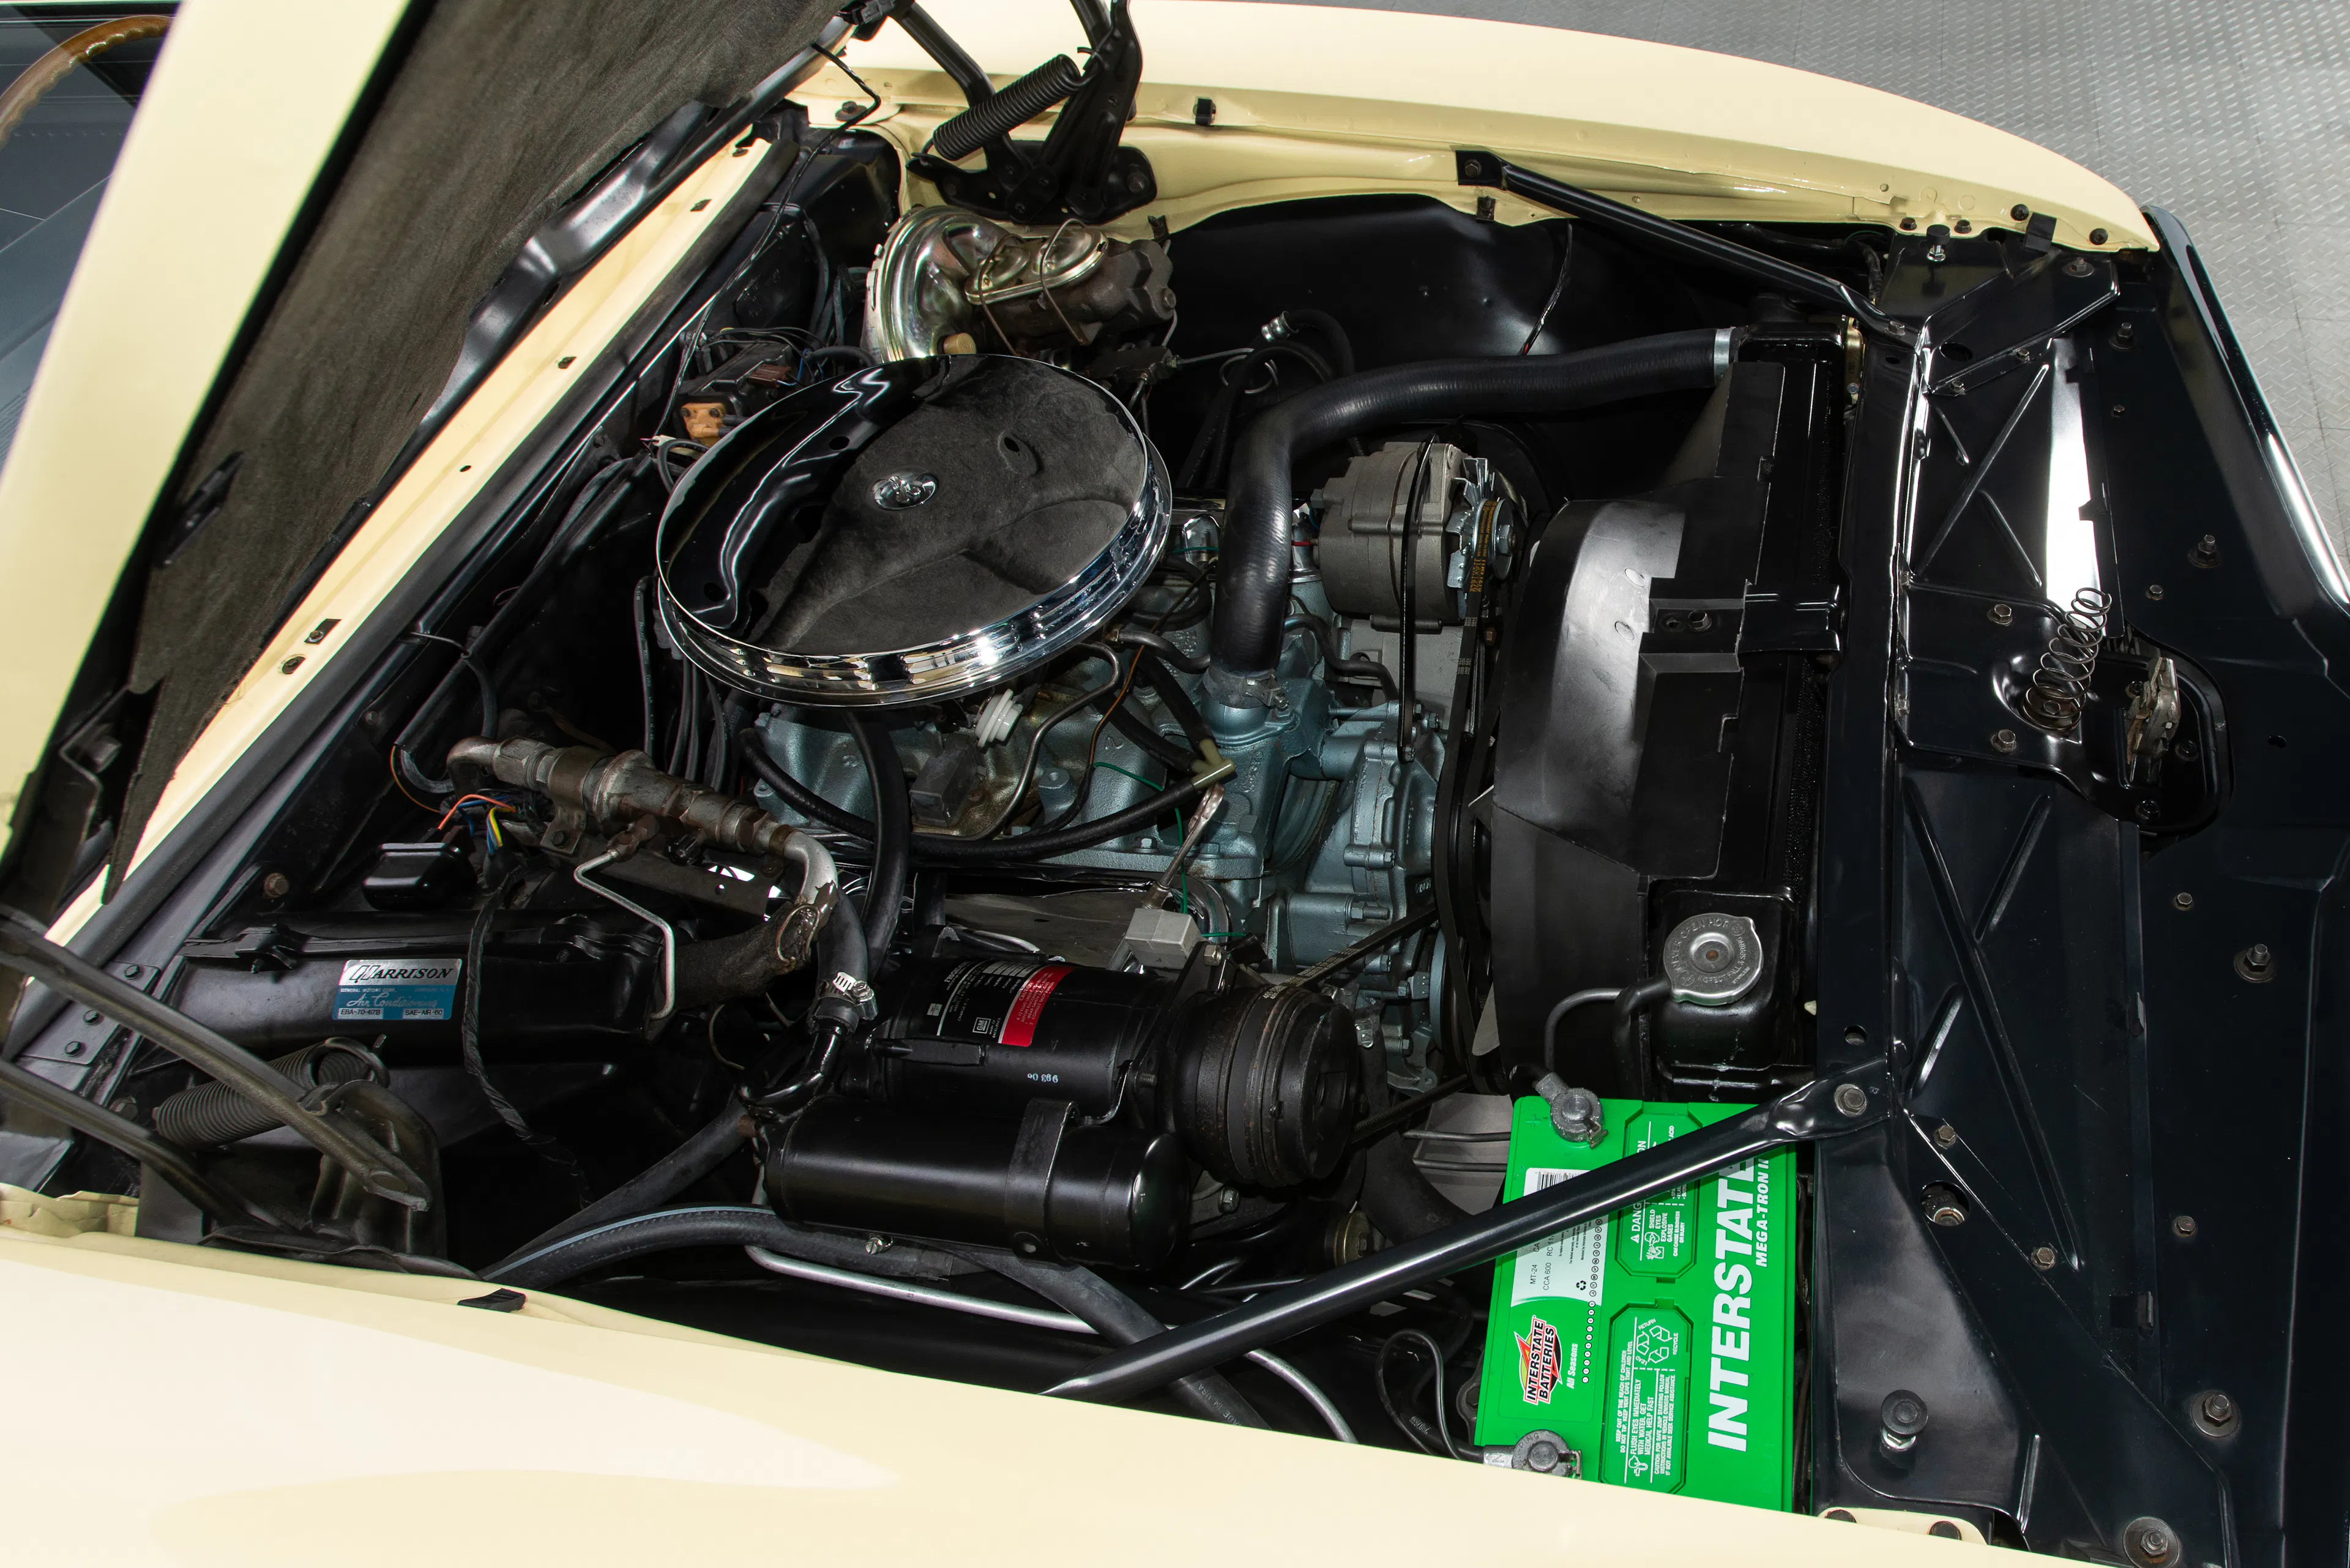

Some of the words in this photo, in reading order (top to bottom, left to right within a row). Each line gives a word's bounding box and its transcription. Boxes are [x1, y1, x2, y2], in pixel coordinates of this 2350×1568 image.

[346, 992, 371, 1007] Air
[371, 992, 438, 1007] Conditioning
[1018, 980, 1034, 1001] CAUTION
[977, 1020, 985, 1031] GM
[1758, 1159, 1769, 1169] II
[1631, 1202, 1642, 1232] DANG
[1755, 1171, 1769, 1267] MEGA-TRON
[1533, 1242, 1540, 1252] CA
[1546, 1247, 1553, 1256] RC
[1707, 1157, 1755, 1452] INTERSTATE
[1638, 1318, 1656, 1331] RETURN
[1527, 1321, 1543, 1401] INTERSTATE
[1539, 1327, 1554, 1399] BATTERIES
[1567, 1343, 1578, 1376] Seasons
[1635, 1356, 1648, 1366] LEAD
[1198, 1383, 1212, 1401] USA
[1566, 1377, 1575, 1389] All
[1632, 1379, 1641, 1417] IMMEDIATELY
